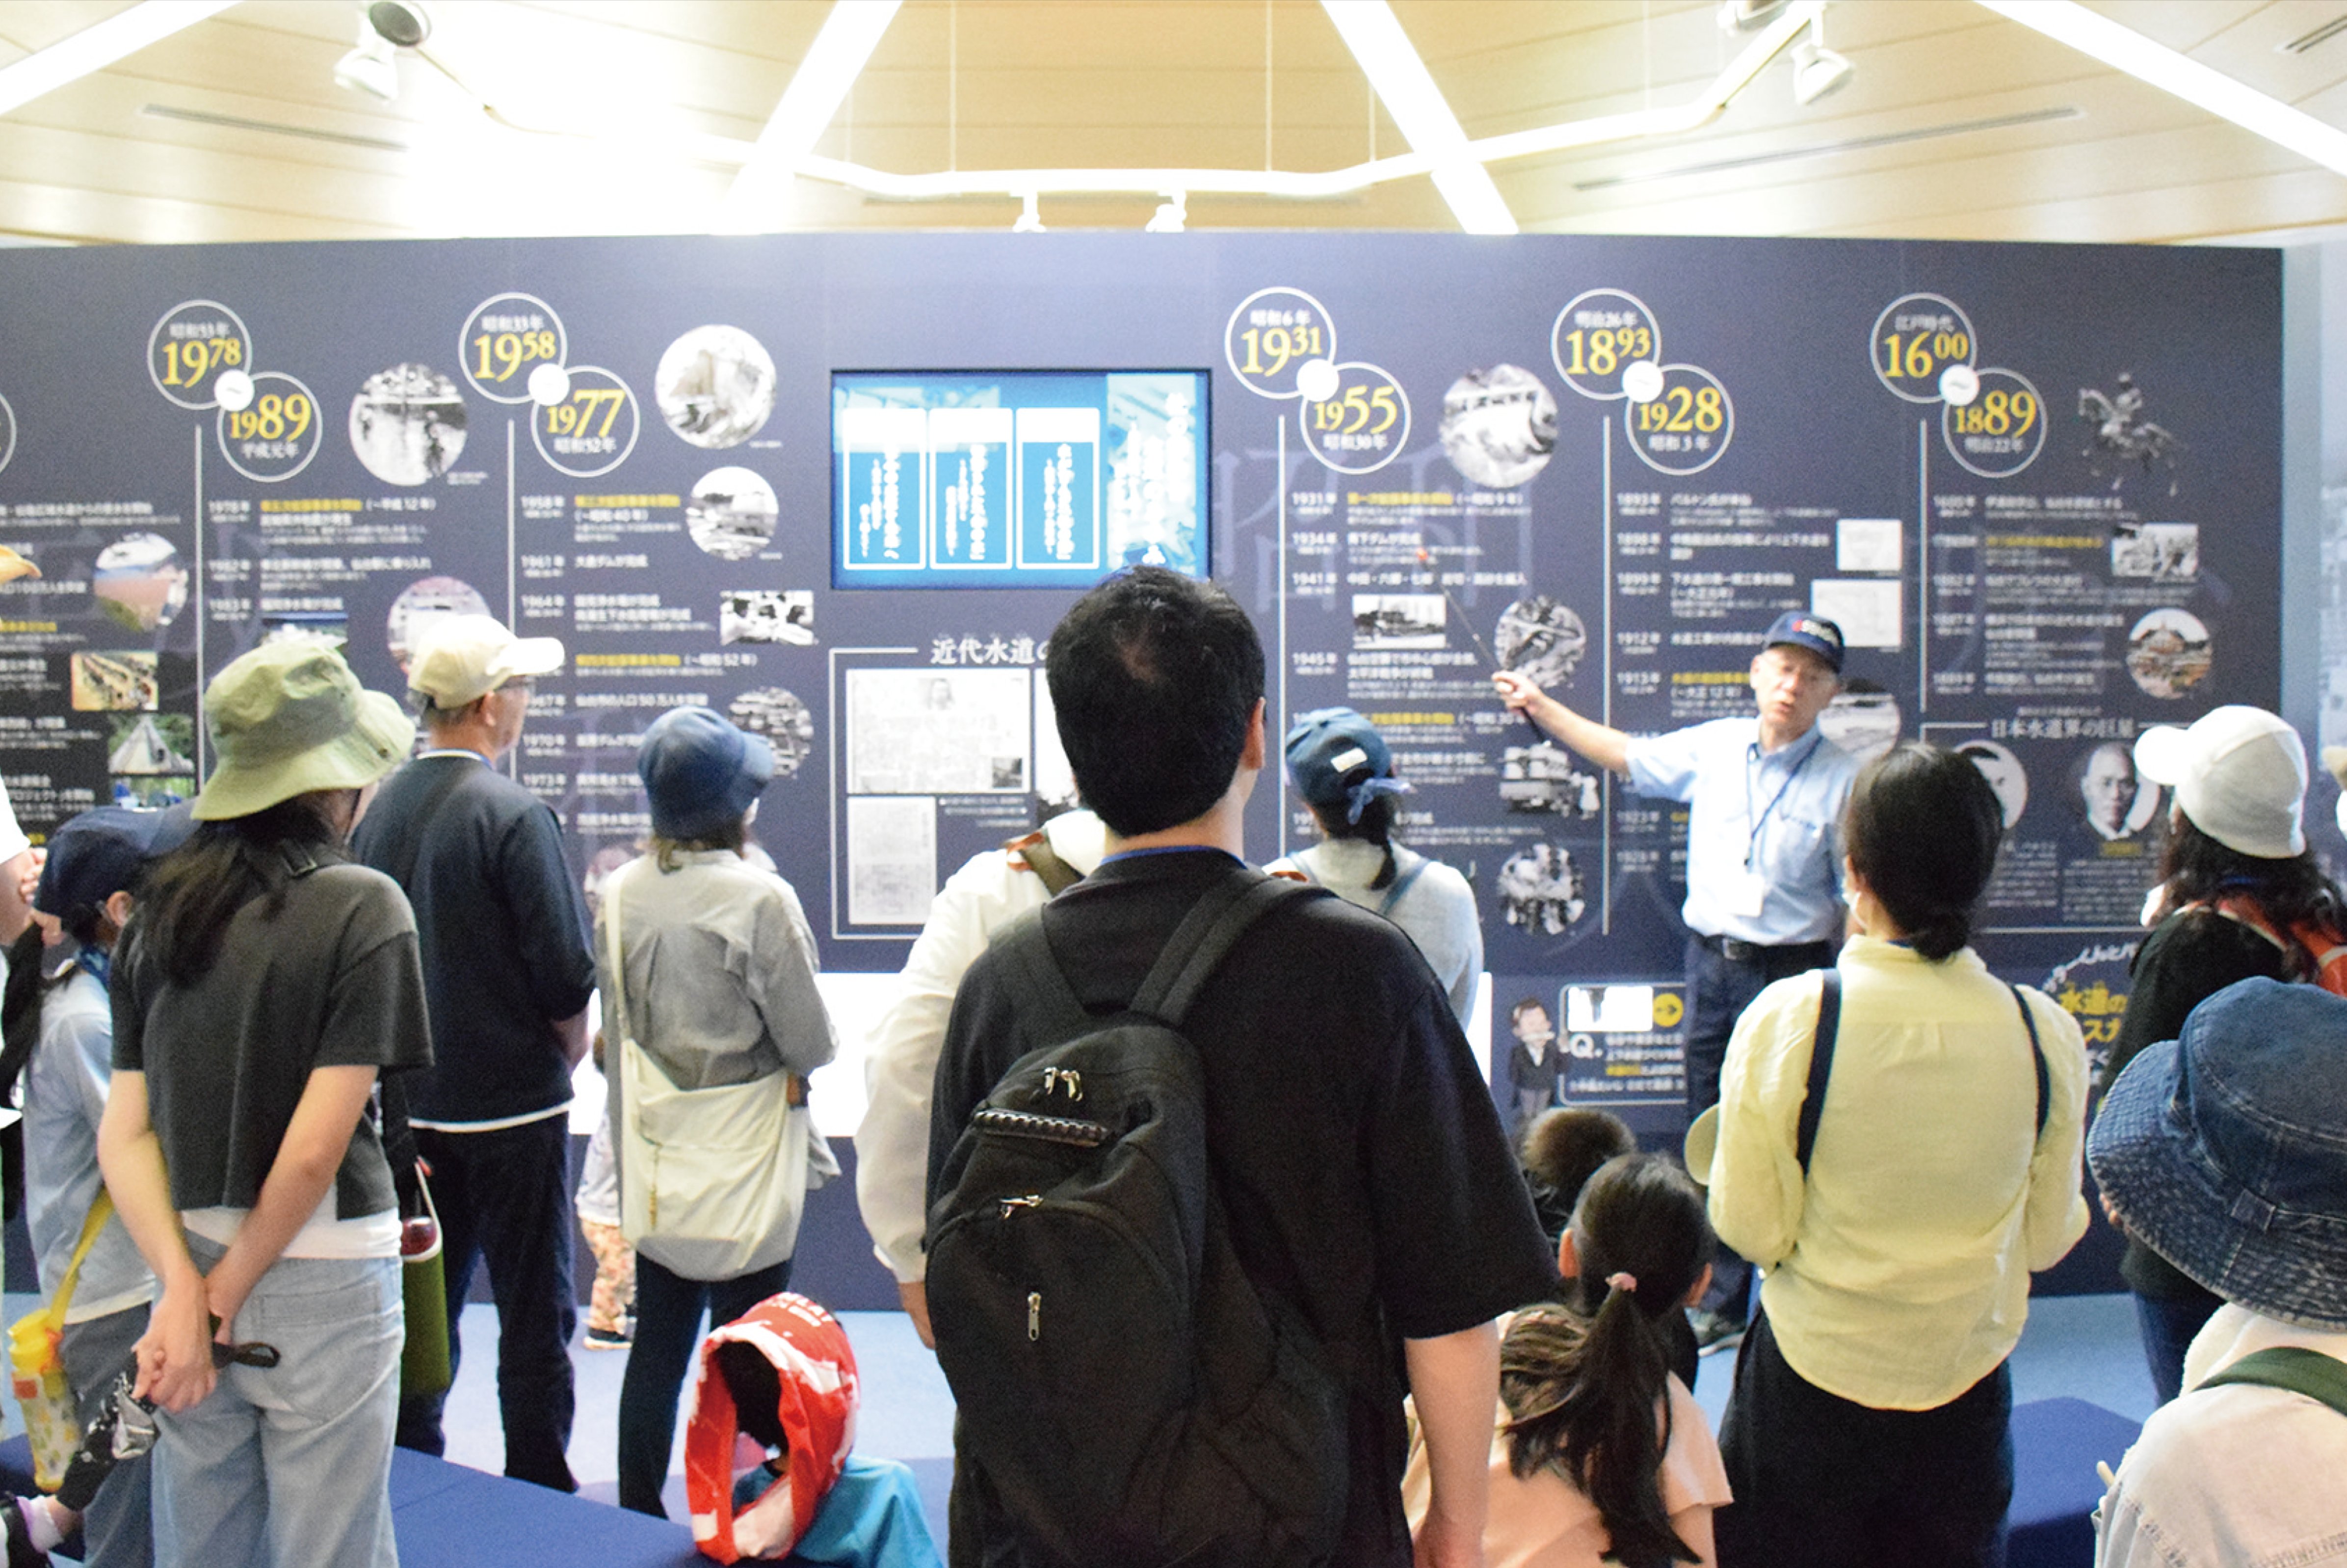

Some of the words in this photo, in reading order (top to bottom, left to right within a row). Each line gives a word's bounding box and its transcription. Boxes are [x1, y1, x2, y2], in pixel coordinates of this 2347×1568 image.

[163, 338, 241, 388] 1978
[475, 331, 555, 381] 1958
[1241, 326, 1321, 376] 1931
[1566, 327, 1652, 375] 1893
[1884, 331, 1969, 378] 1600
[231, 394, 311, 442] 1989
[547, 389, 626, 437] 1977
[1315, 385, 1398, 436] 1955
[1640, 386, 1723, 433] 1928
[1956, 391, 2036, 437] 1889
[1569, 1032, 1603, 1058] Q.
